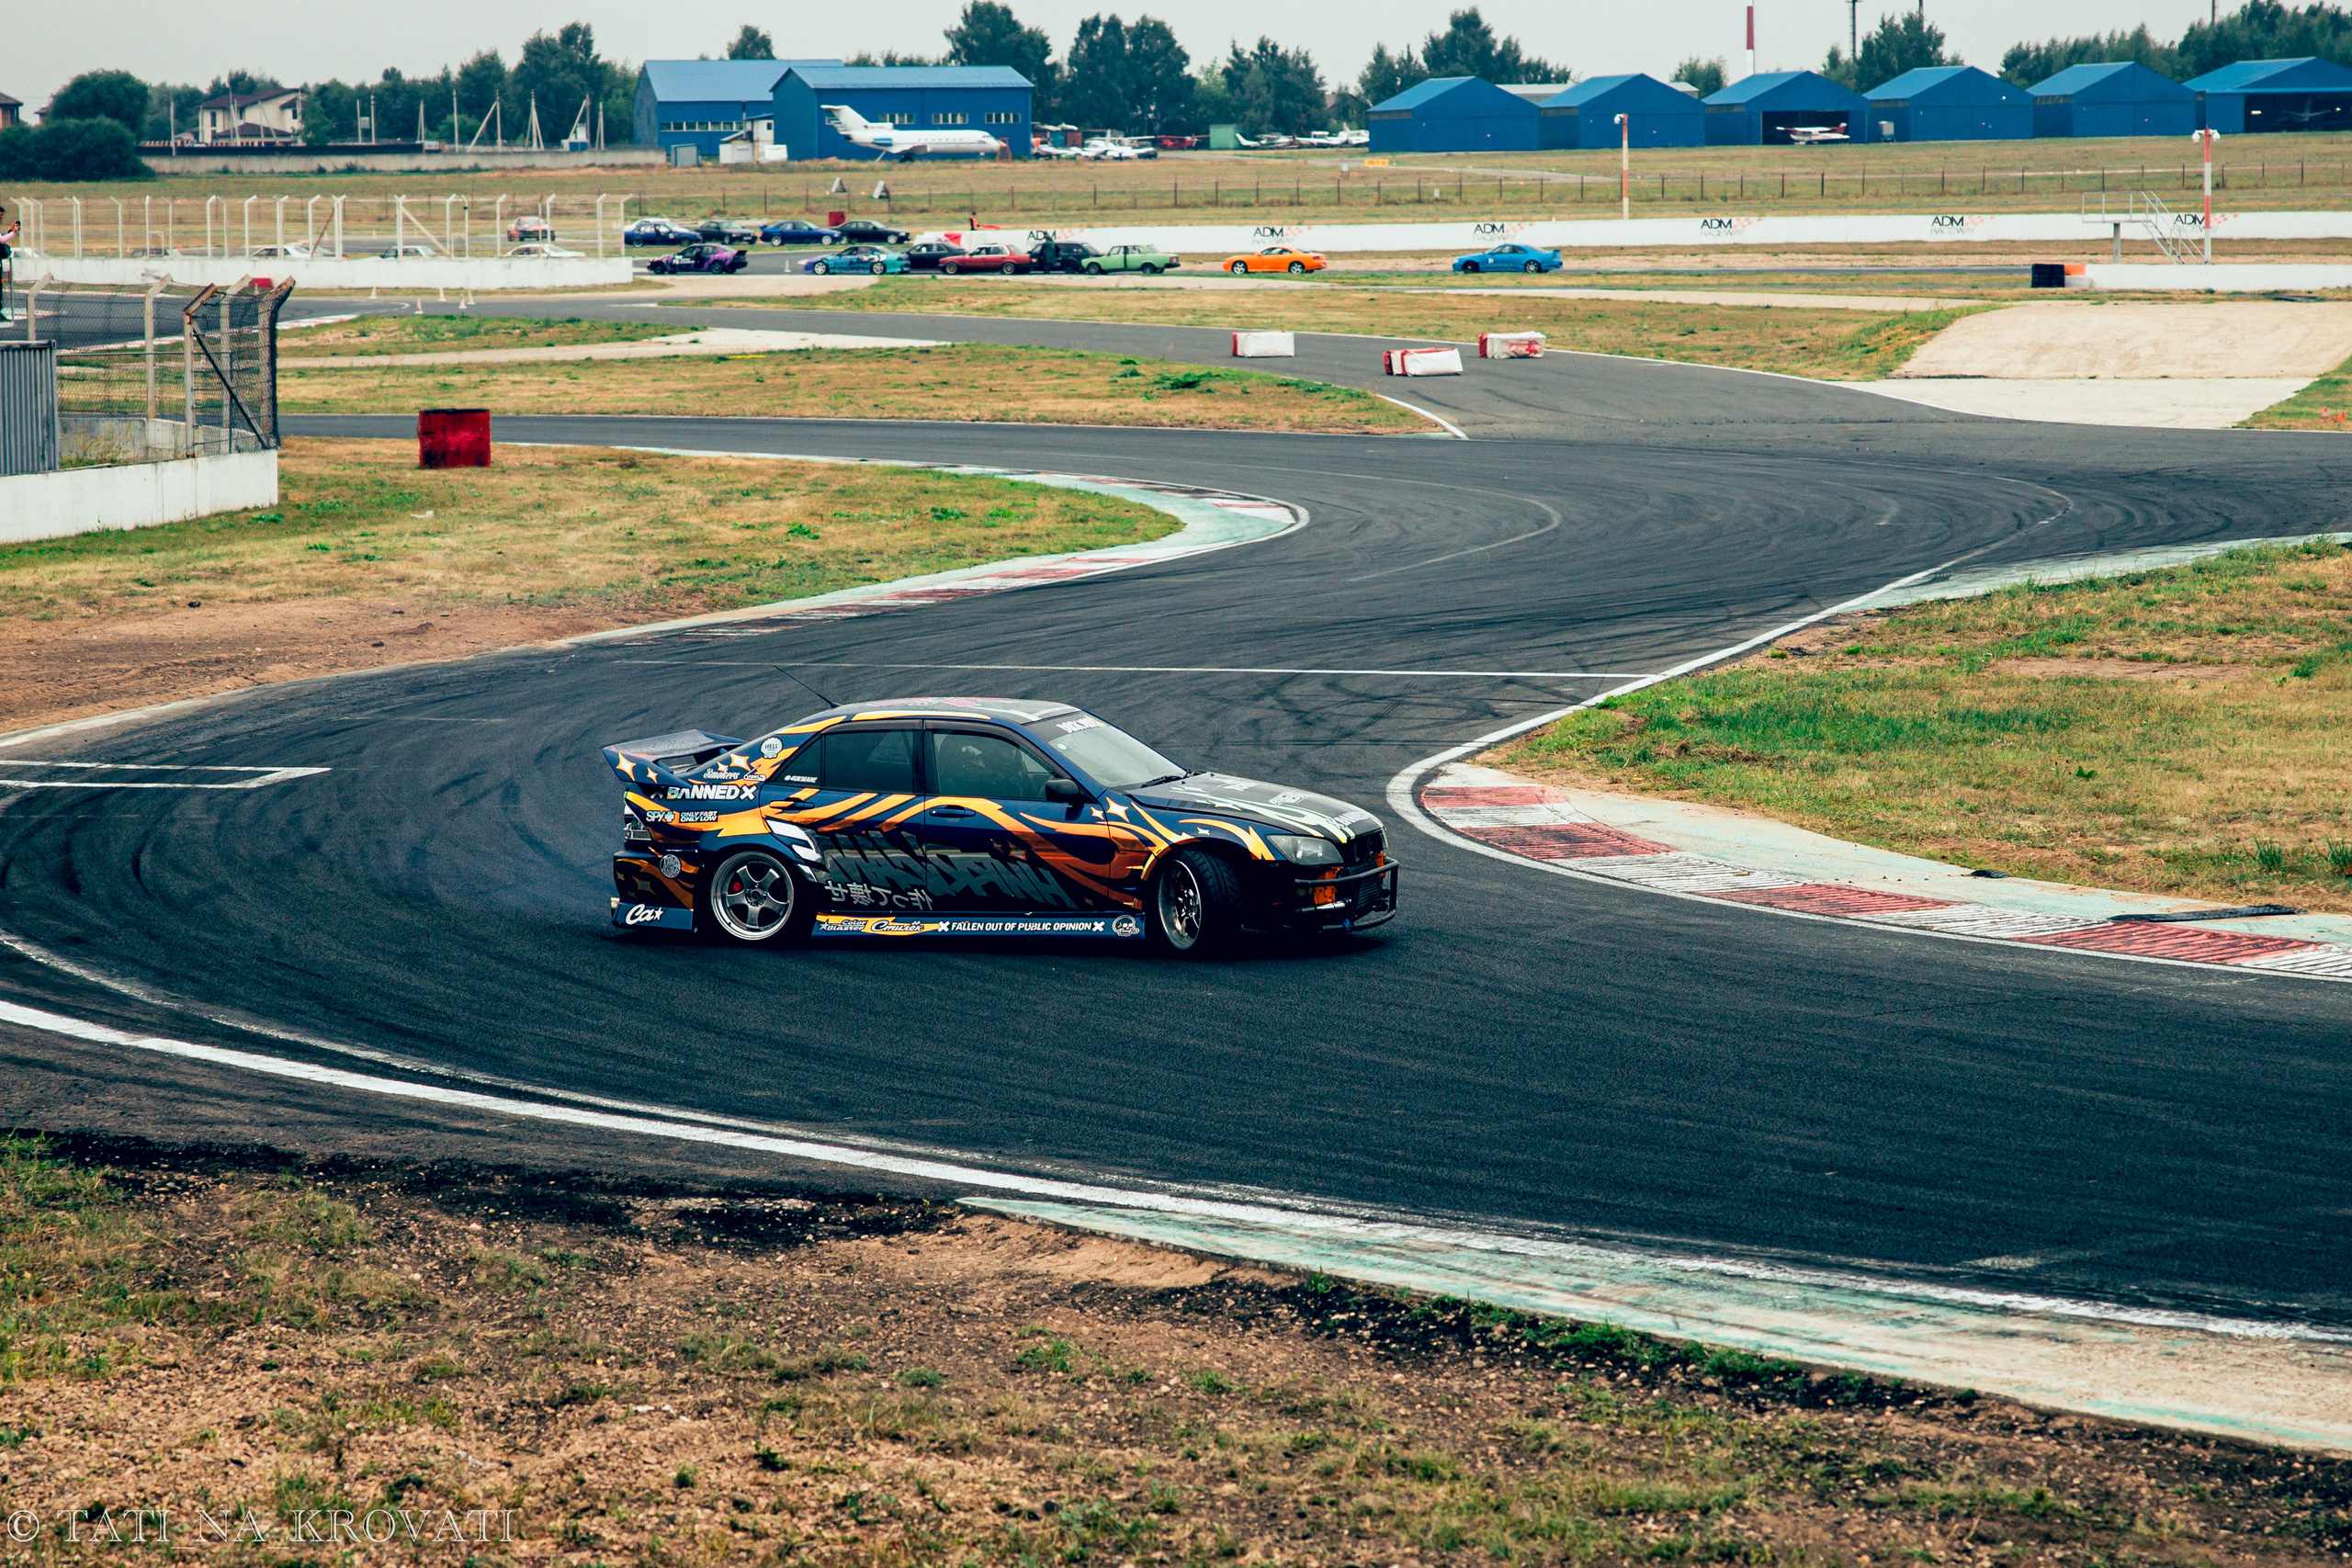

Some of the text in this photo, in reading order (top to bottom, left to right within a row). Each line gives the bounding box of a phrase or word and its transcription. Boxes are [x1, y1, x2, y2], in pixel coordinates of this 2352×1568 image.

[1701, 219, 1733, 229] ADM
[1932, 216, 1964, 226] ADM
[1253, 227, 1283, 237] ADM
[1474, 223, 1505, 234] ADM
[703, 768, 741, 781] Smokers
[951, 922, 984, 931] FALLEN
[985, 922, 1004, 931] OUT
[1005, 922, 1017, 931] OF
[1018, 922, 1052, 931] PUBLIC
[1053, 922, 1091, 931] OPINION
